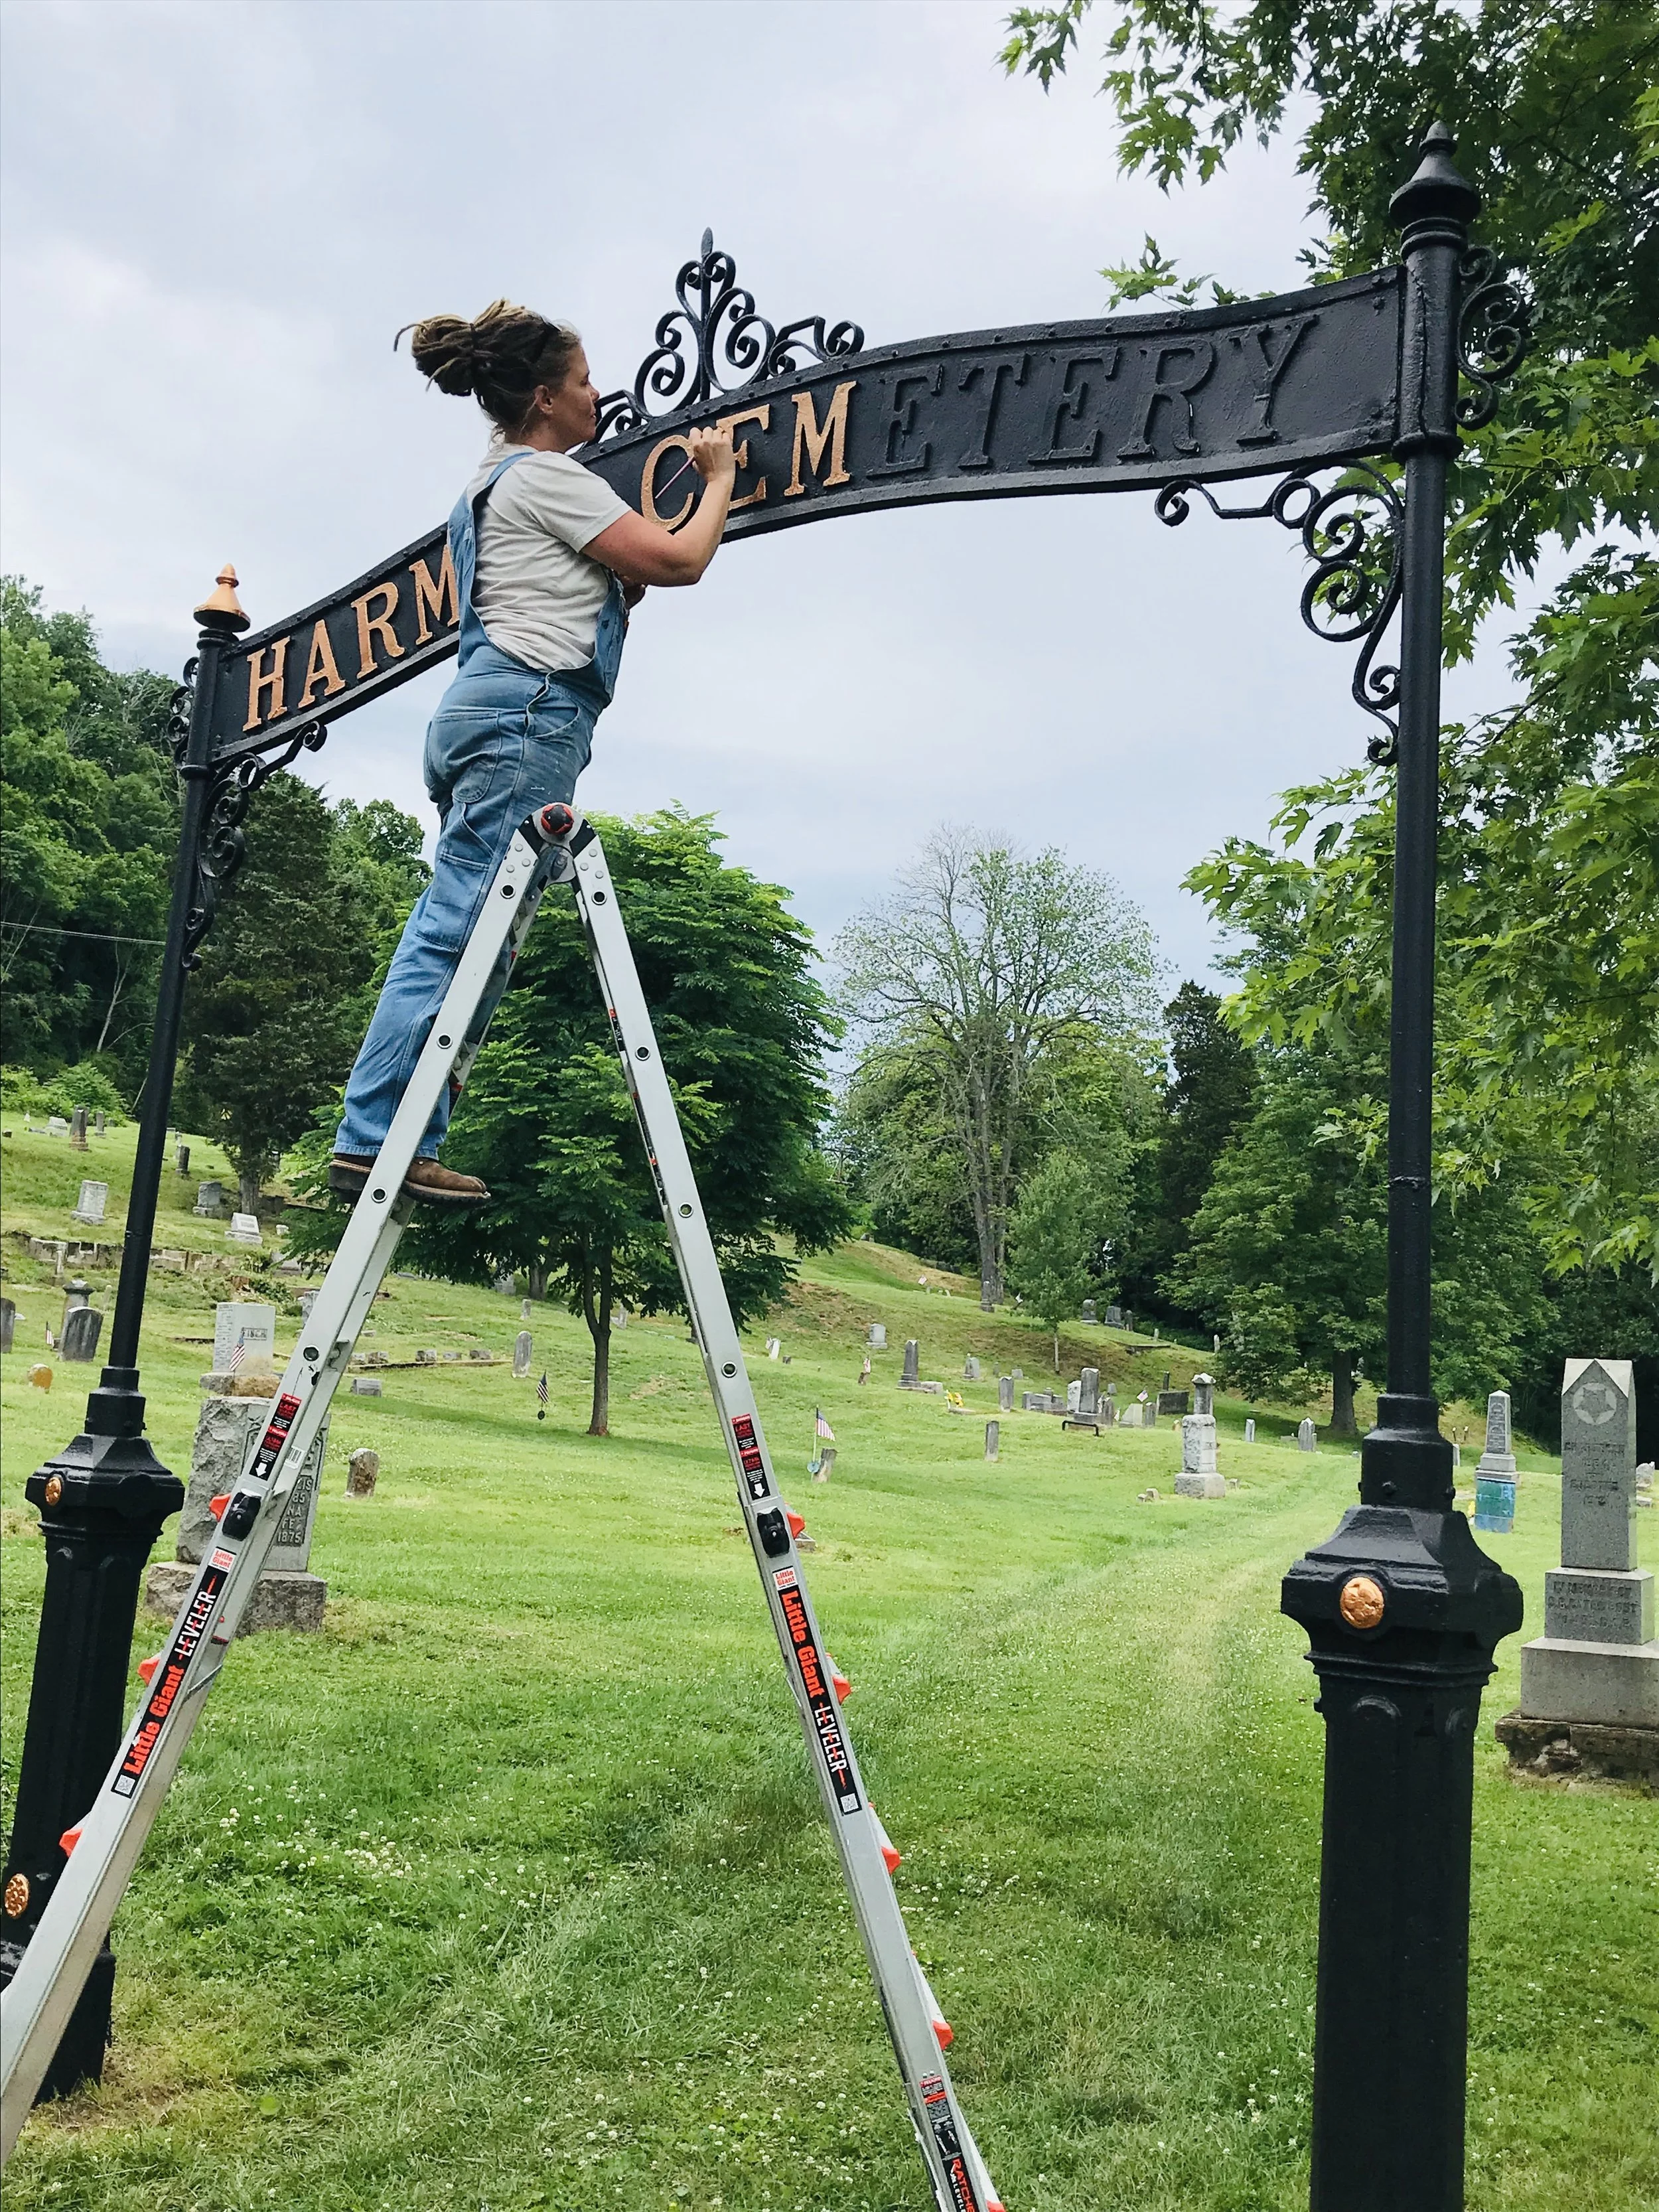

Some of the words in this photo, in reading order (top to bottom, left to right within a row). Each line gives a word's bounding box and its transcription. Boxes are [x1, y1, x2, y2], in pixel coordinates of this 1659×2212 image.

[640, 310, 1321, 531] CEMETERY
[277, 1530, 302, 1543] 1875
[212, 1556, 231, 1568] Giant
[214, 1550, 233, 1562] Little
[776, 1570, 794, 1580] Little
[777, 1576, 795, 1585] Giant
[123, 1721, 161, 1775] Little
[149, 1664, 184, 1718] Giant
[174, 1591, 216, 1657] LEVELER
[781, 1590, 808, 1643] Little
[798, 1645, 825, 1698] Giant
[814, 1706, 847, 1773] LEVELER
